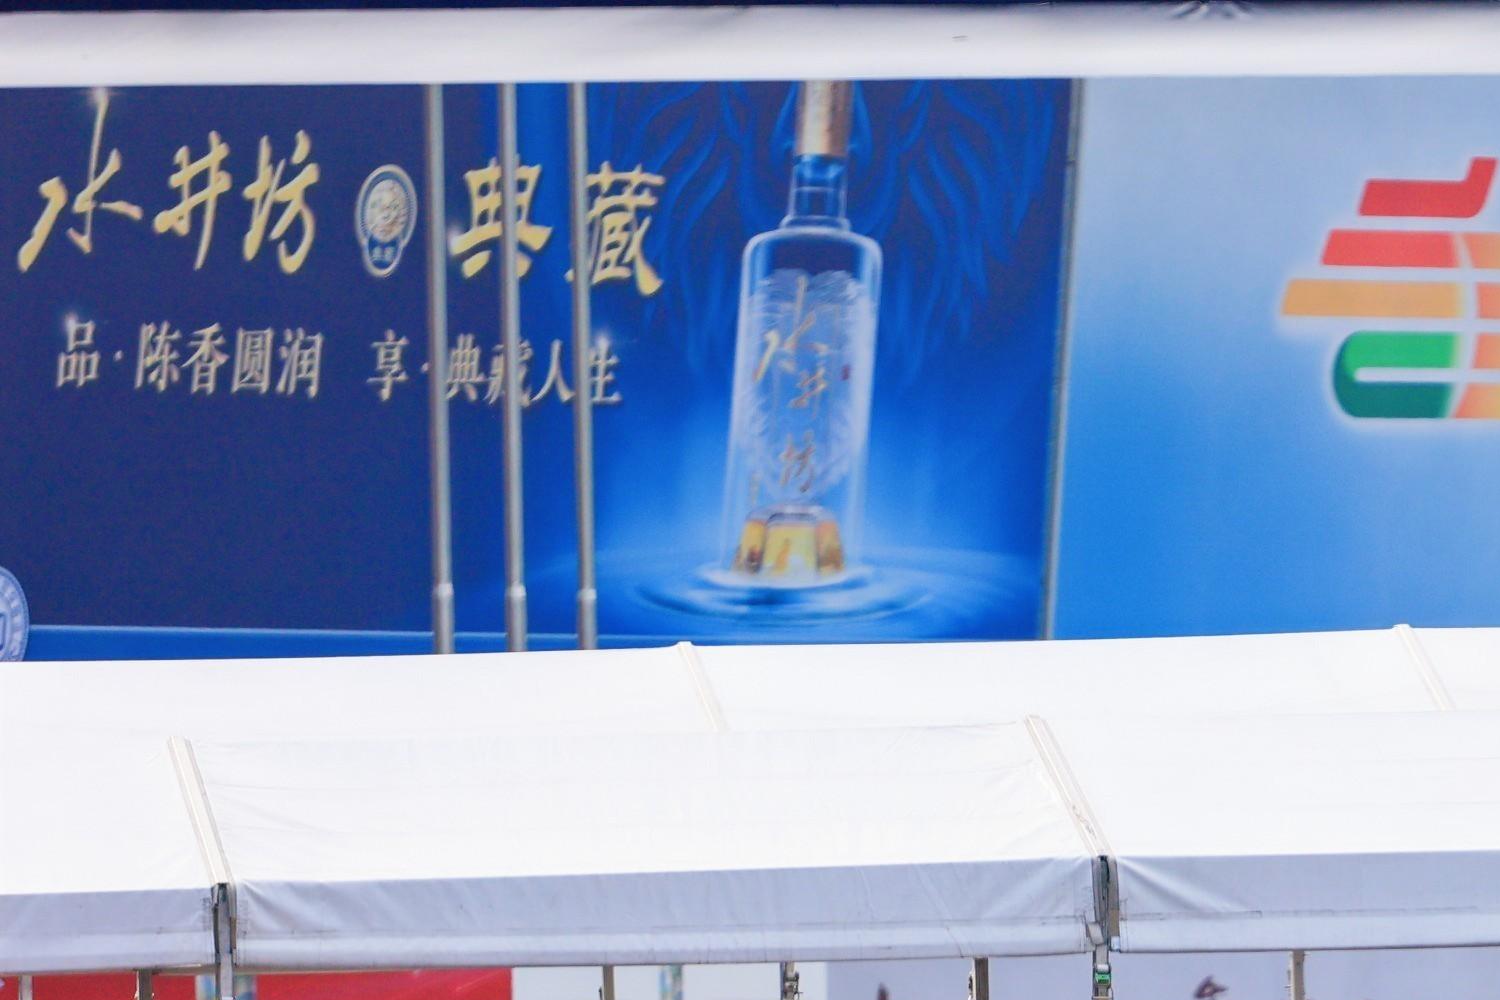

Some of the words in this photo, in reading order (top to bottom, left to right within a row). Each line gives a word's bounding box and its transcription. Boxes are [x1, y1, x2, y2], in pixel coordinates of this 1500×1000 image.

[18, 86, 320, 274] 水井坊
[450, 157, 665, 296] 典藏
